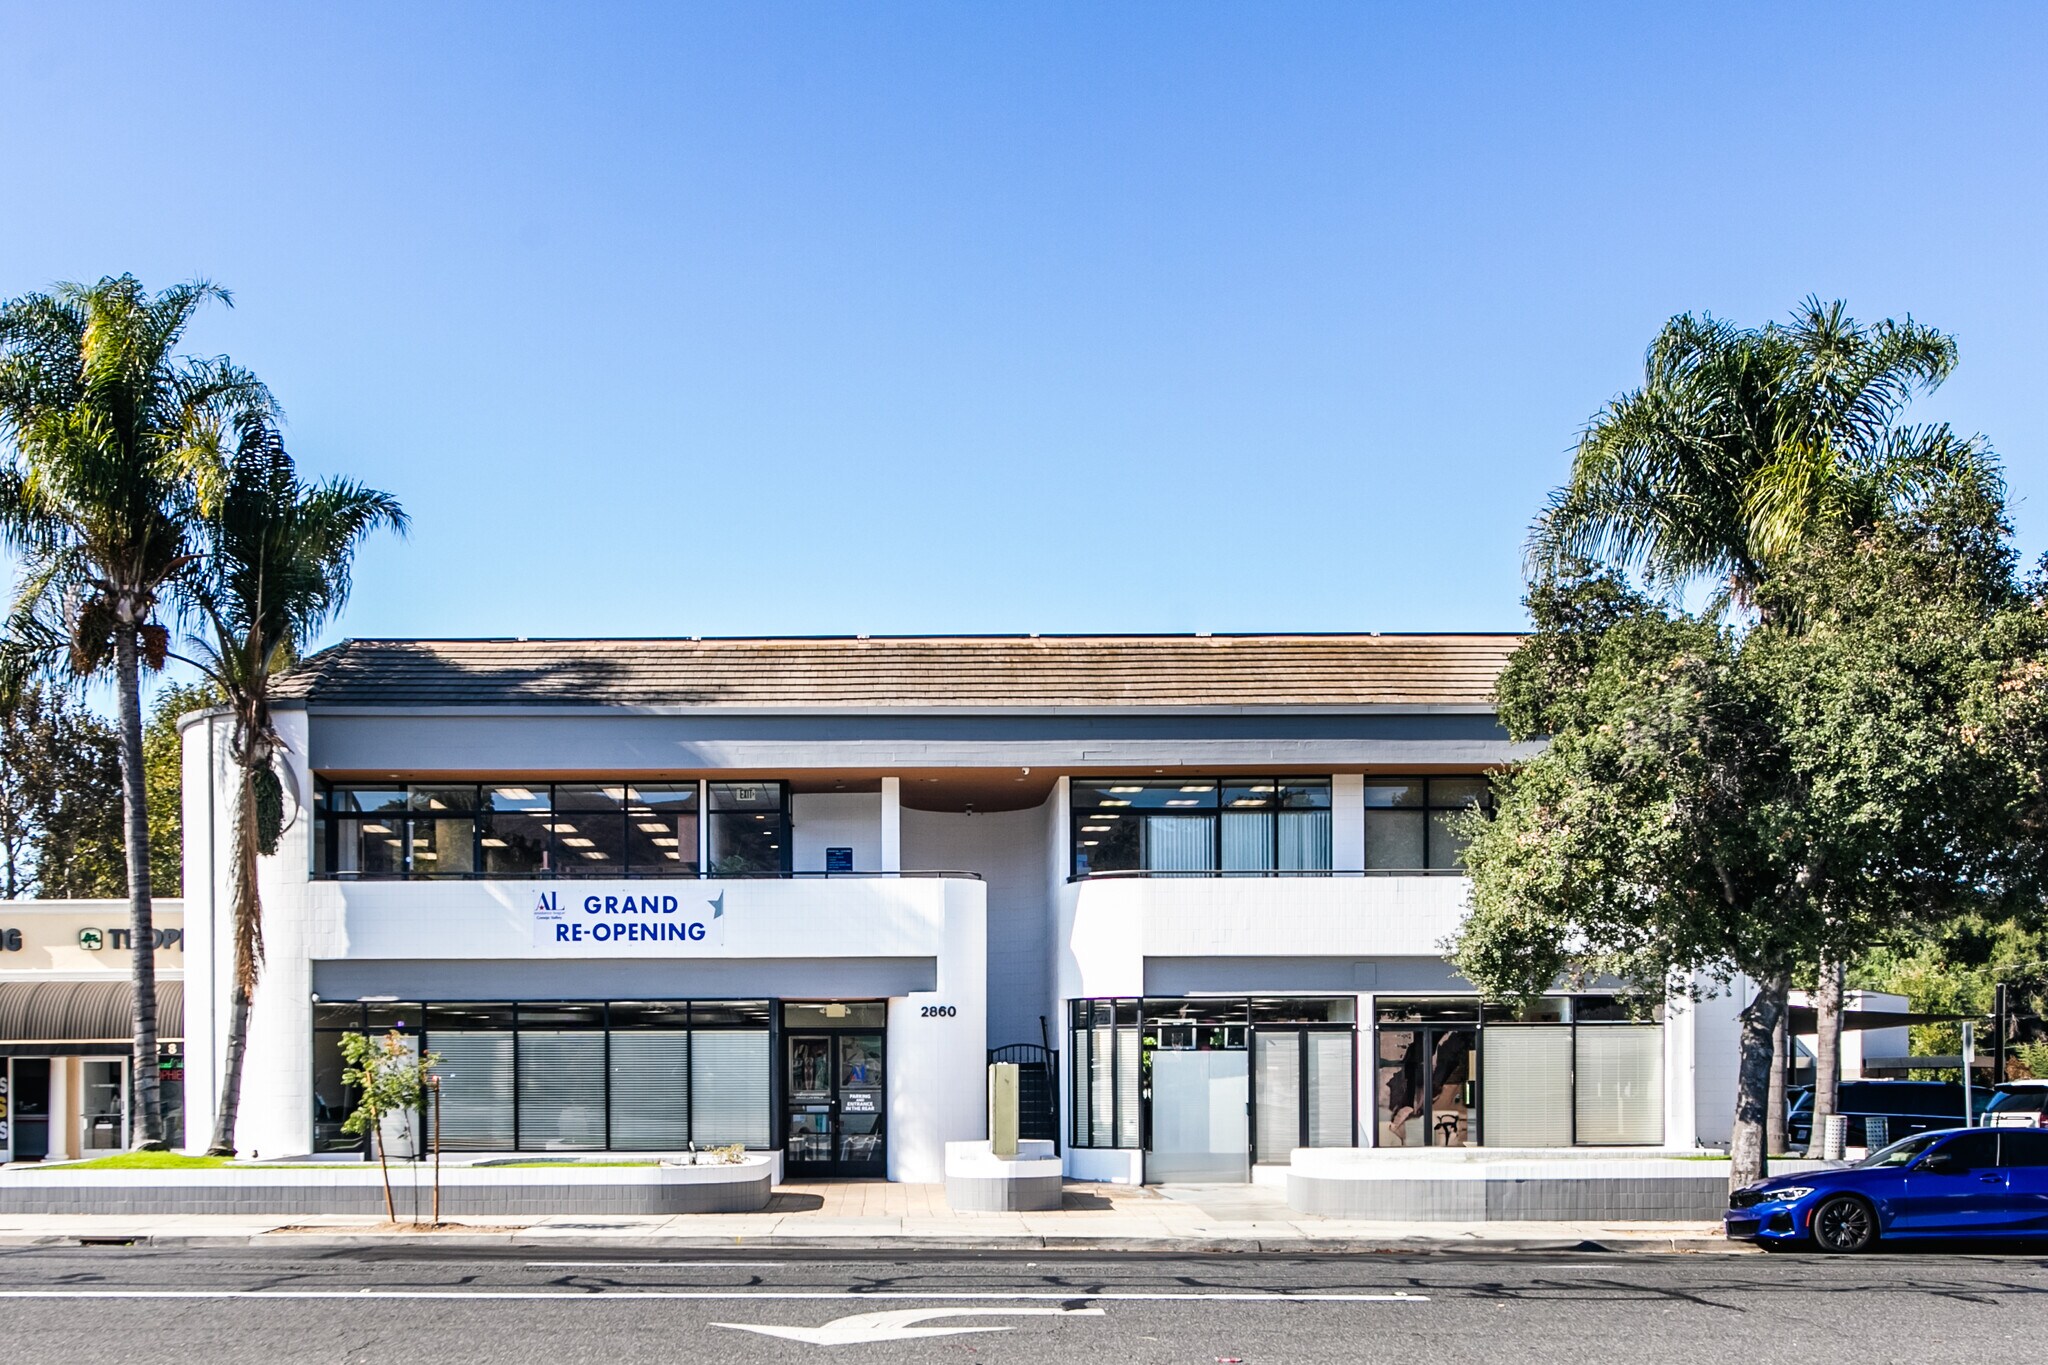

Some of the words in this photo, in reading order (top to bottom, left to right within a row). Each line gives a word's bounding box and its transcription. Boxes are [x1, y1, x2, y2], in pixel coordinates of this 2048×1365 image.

[740, 789, 752, 799] EXIT
[535, 891, 565, 911] AL
[584, 896, 678, 914] GRAND
[0, 928, 22, 951] G
[556, 923, 706, 942] RE-OPENING
[921, 1006, 957, 1018] 2860
